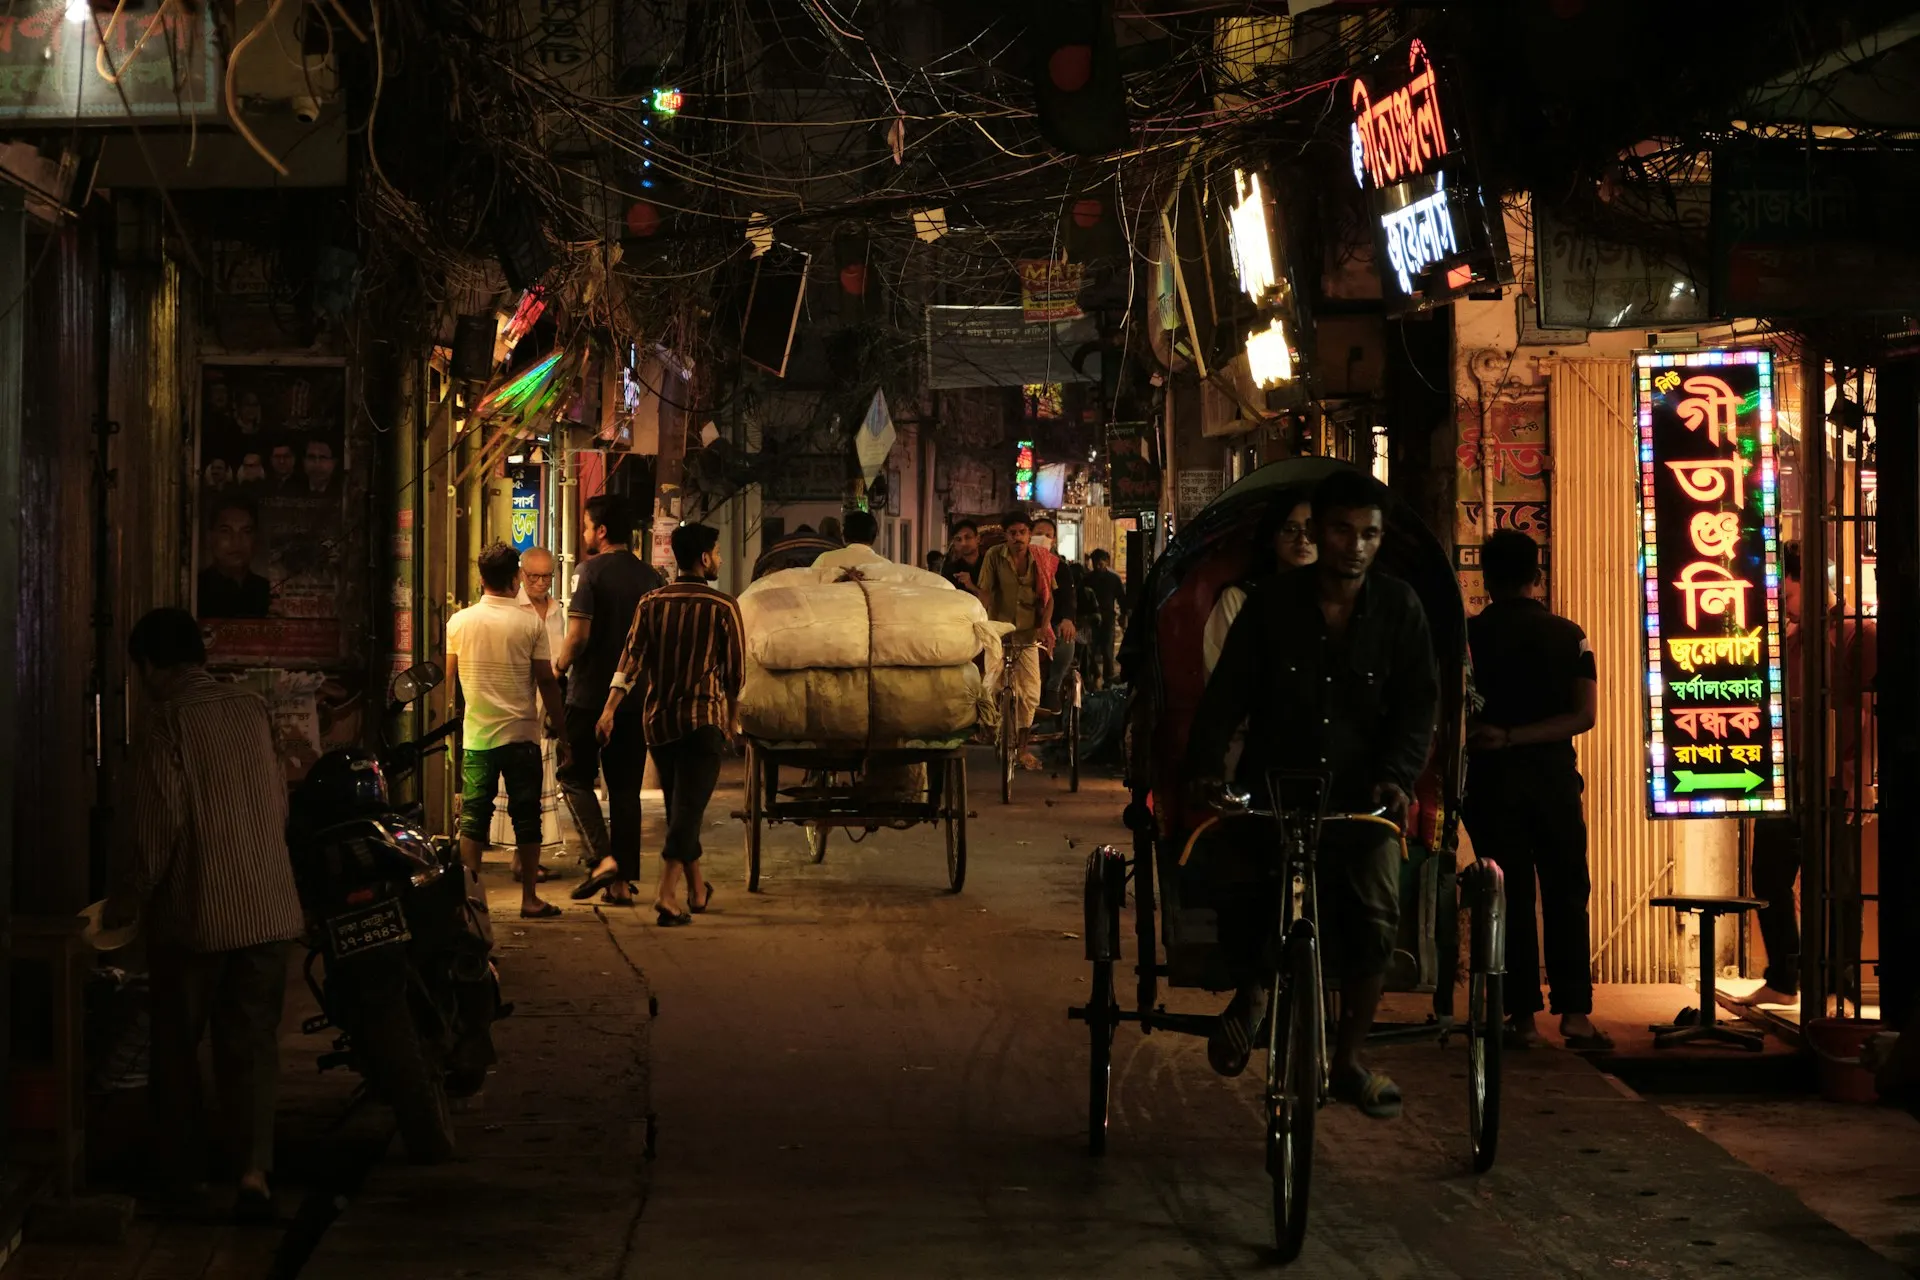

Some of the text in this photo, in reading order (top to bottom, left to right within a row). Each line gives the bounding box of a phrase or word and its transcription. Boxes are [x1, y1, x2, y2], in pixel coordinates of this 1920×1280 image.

[1381, 170, 1457, 295] জুয়েলার্স
[1655, 371, 1682, 395] নিউ
[1667, 626, 1762, 673] জুয়েলার্স
[1670, 674, 1763, 700] স্বর্ণালংকার
[1671, 706, 1761, 740] বন্ধক
[1674, 744, 1762, 765] রাখা হয়
